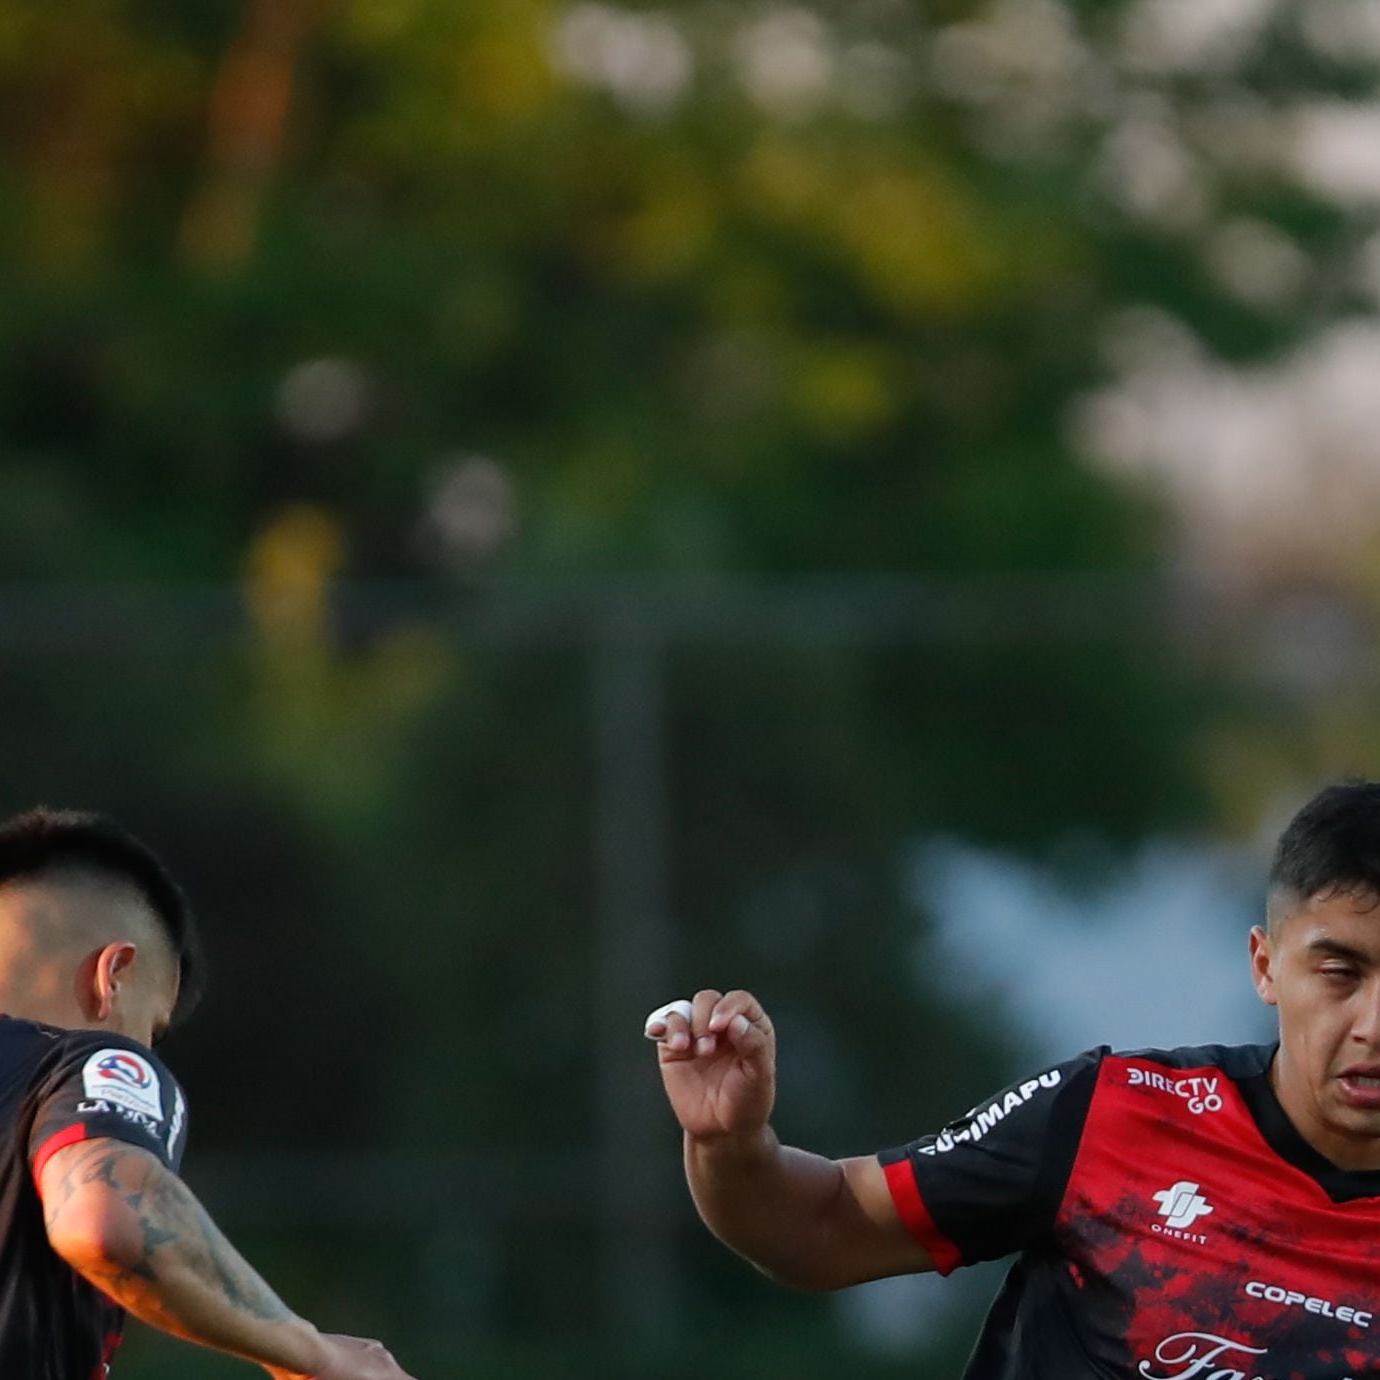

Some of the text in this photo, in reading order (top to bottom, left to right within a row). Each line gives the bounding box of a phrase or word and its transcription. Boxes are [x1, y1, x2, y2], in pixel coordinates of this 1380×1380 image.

[1126, 1067, 1218, 1099] DIRECTV
[1187, 1094, 1222, 1115] GO
[1151, 1223, 1208, 1245] ONEFIT
[1245, 1280, 1373, 1328] COPELEC
